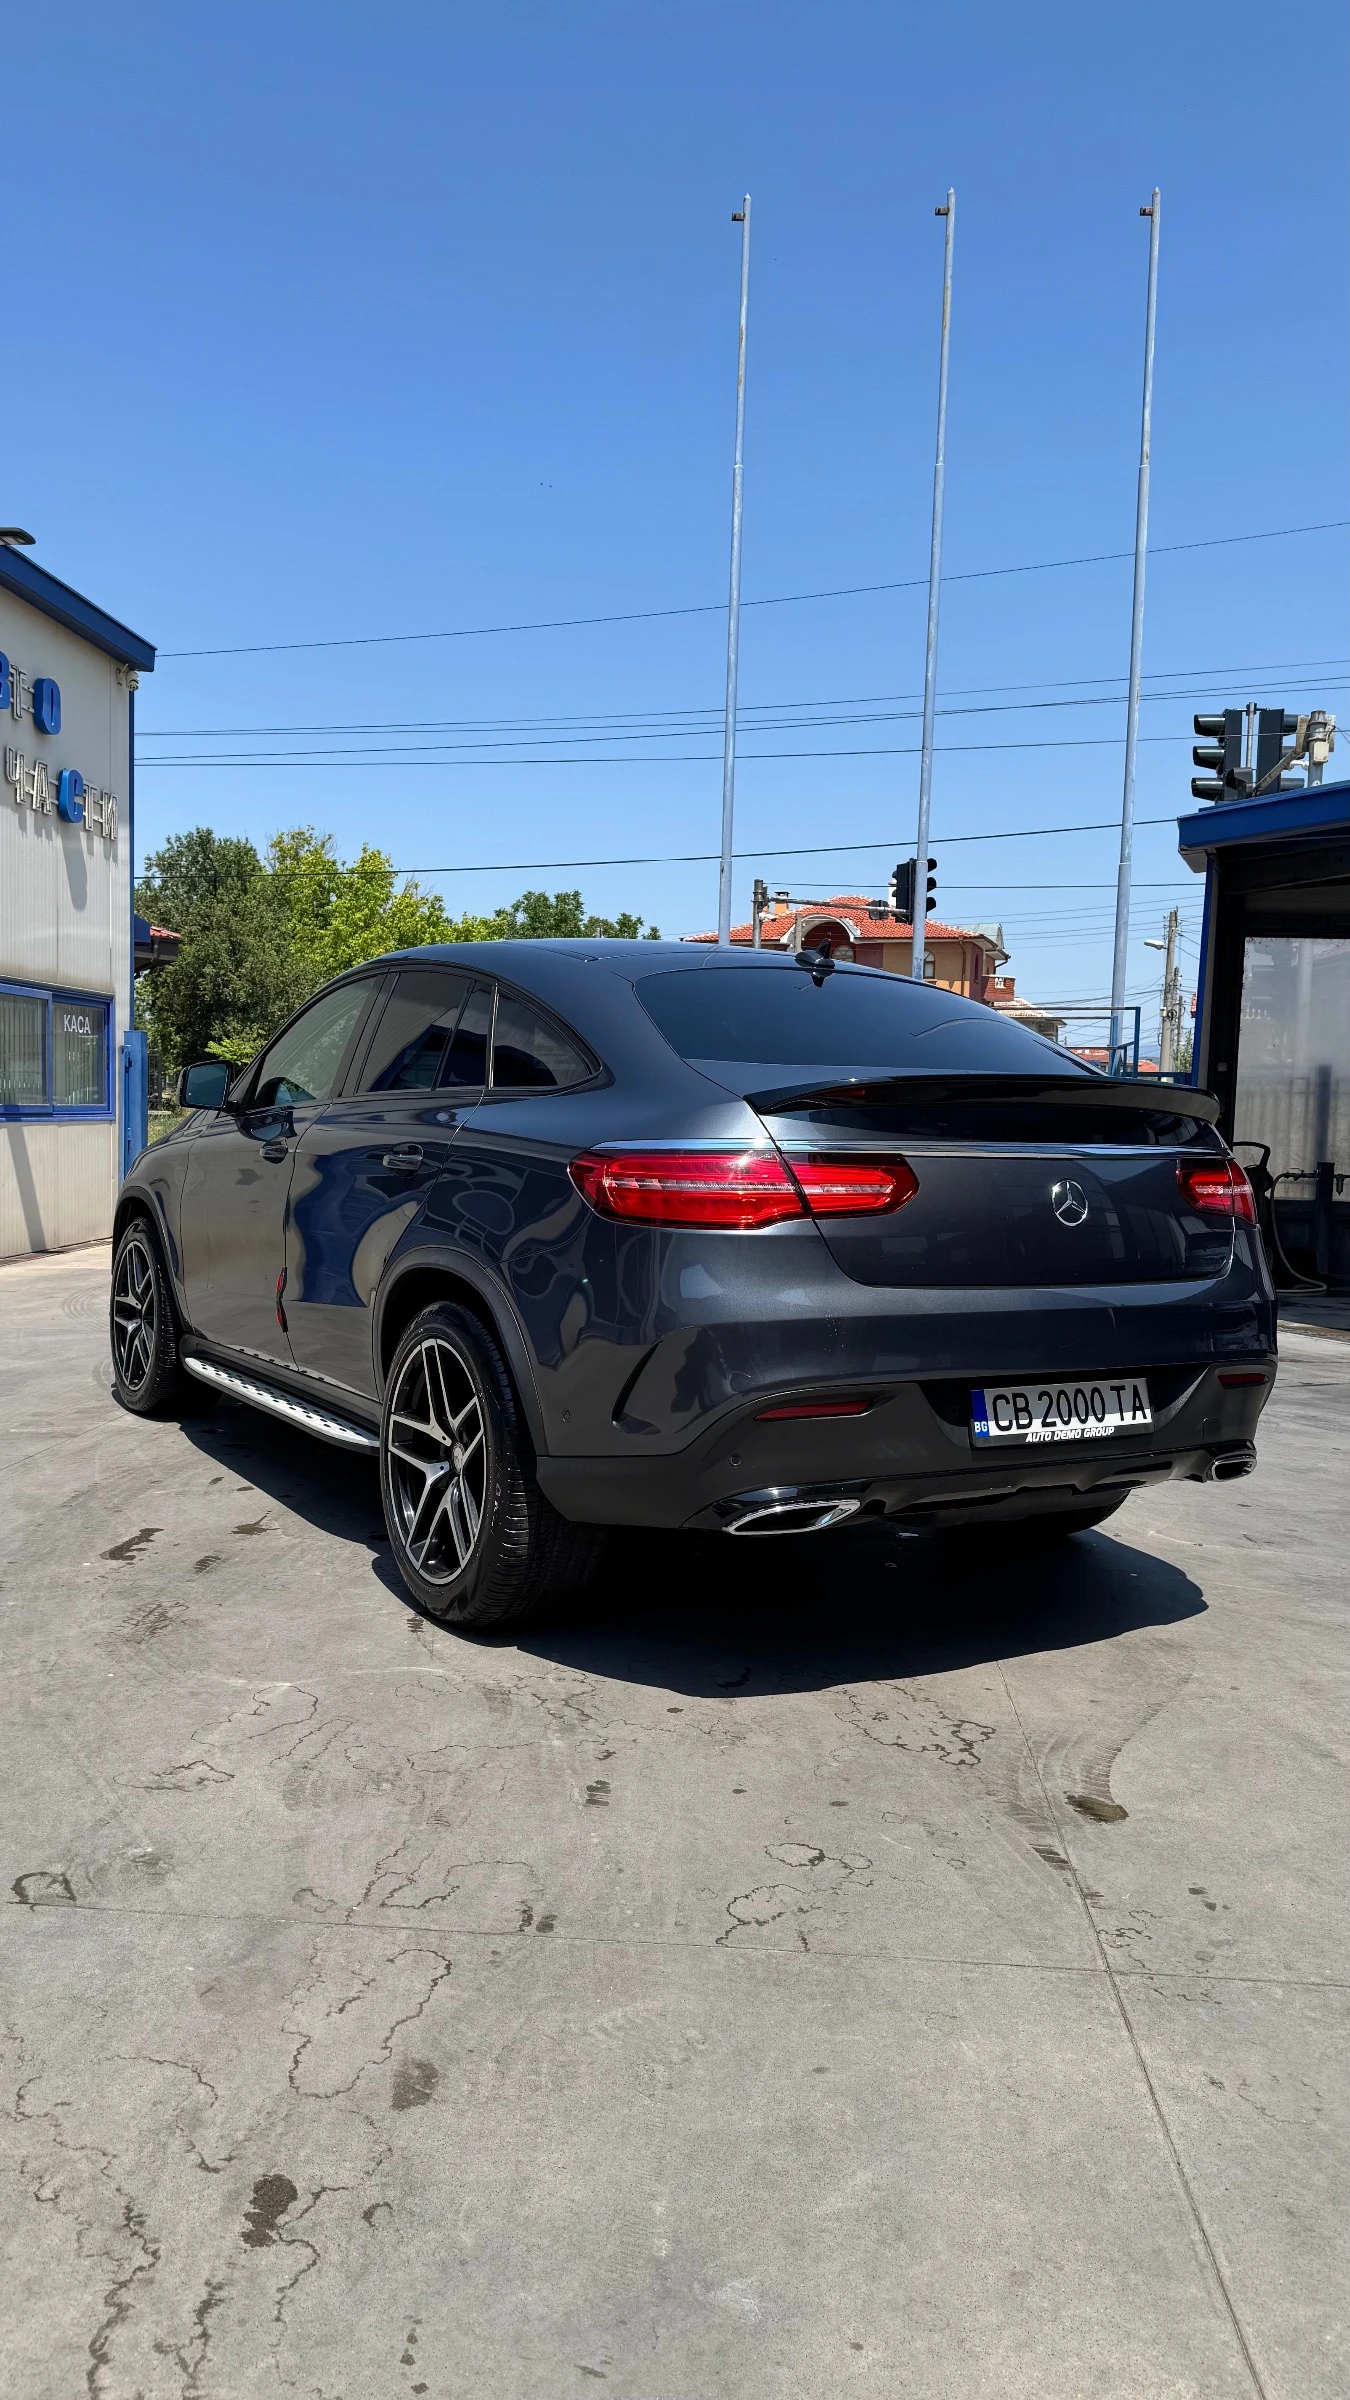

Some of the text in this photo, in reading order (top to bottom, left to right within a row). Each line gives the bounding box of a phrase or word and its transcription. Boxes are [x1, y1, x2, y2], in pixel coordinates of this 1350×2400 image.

[6, 744, 118, 840] ЧАСТИ
[64, 1014, 91, 1034] КАСА
[992, 1384, 1147, 1432] CB 2000 TA
[974, 1421, 989, 1433] BG
[1026, 1427, 1115, 1443] AUTO DEMO GROUP
